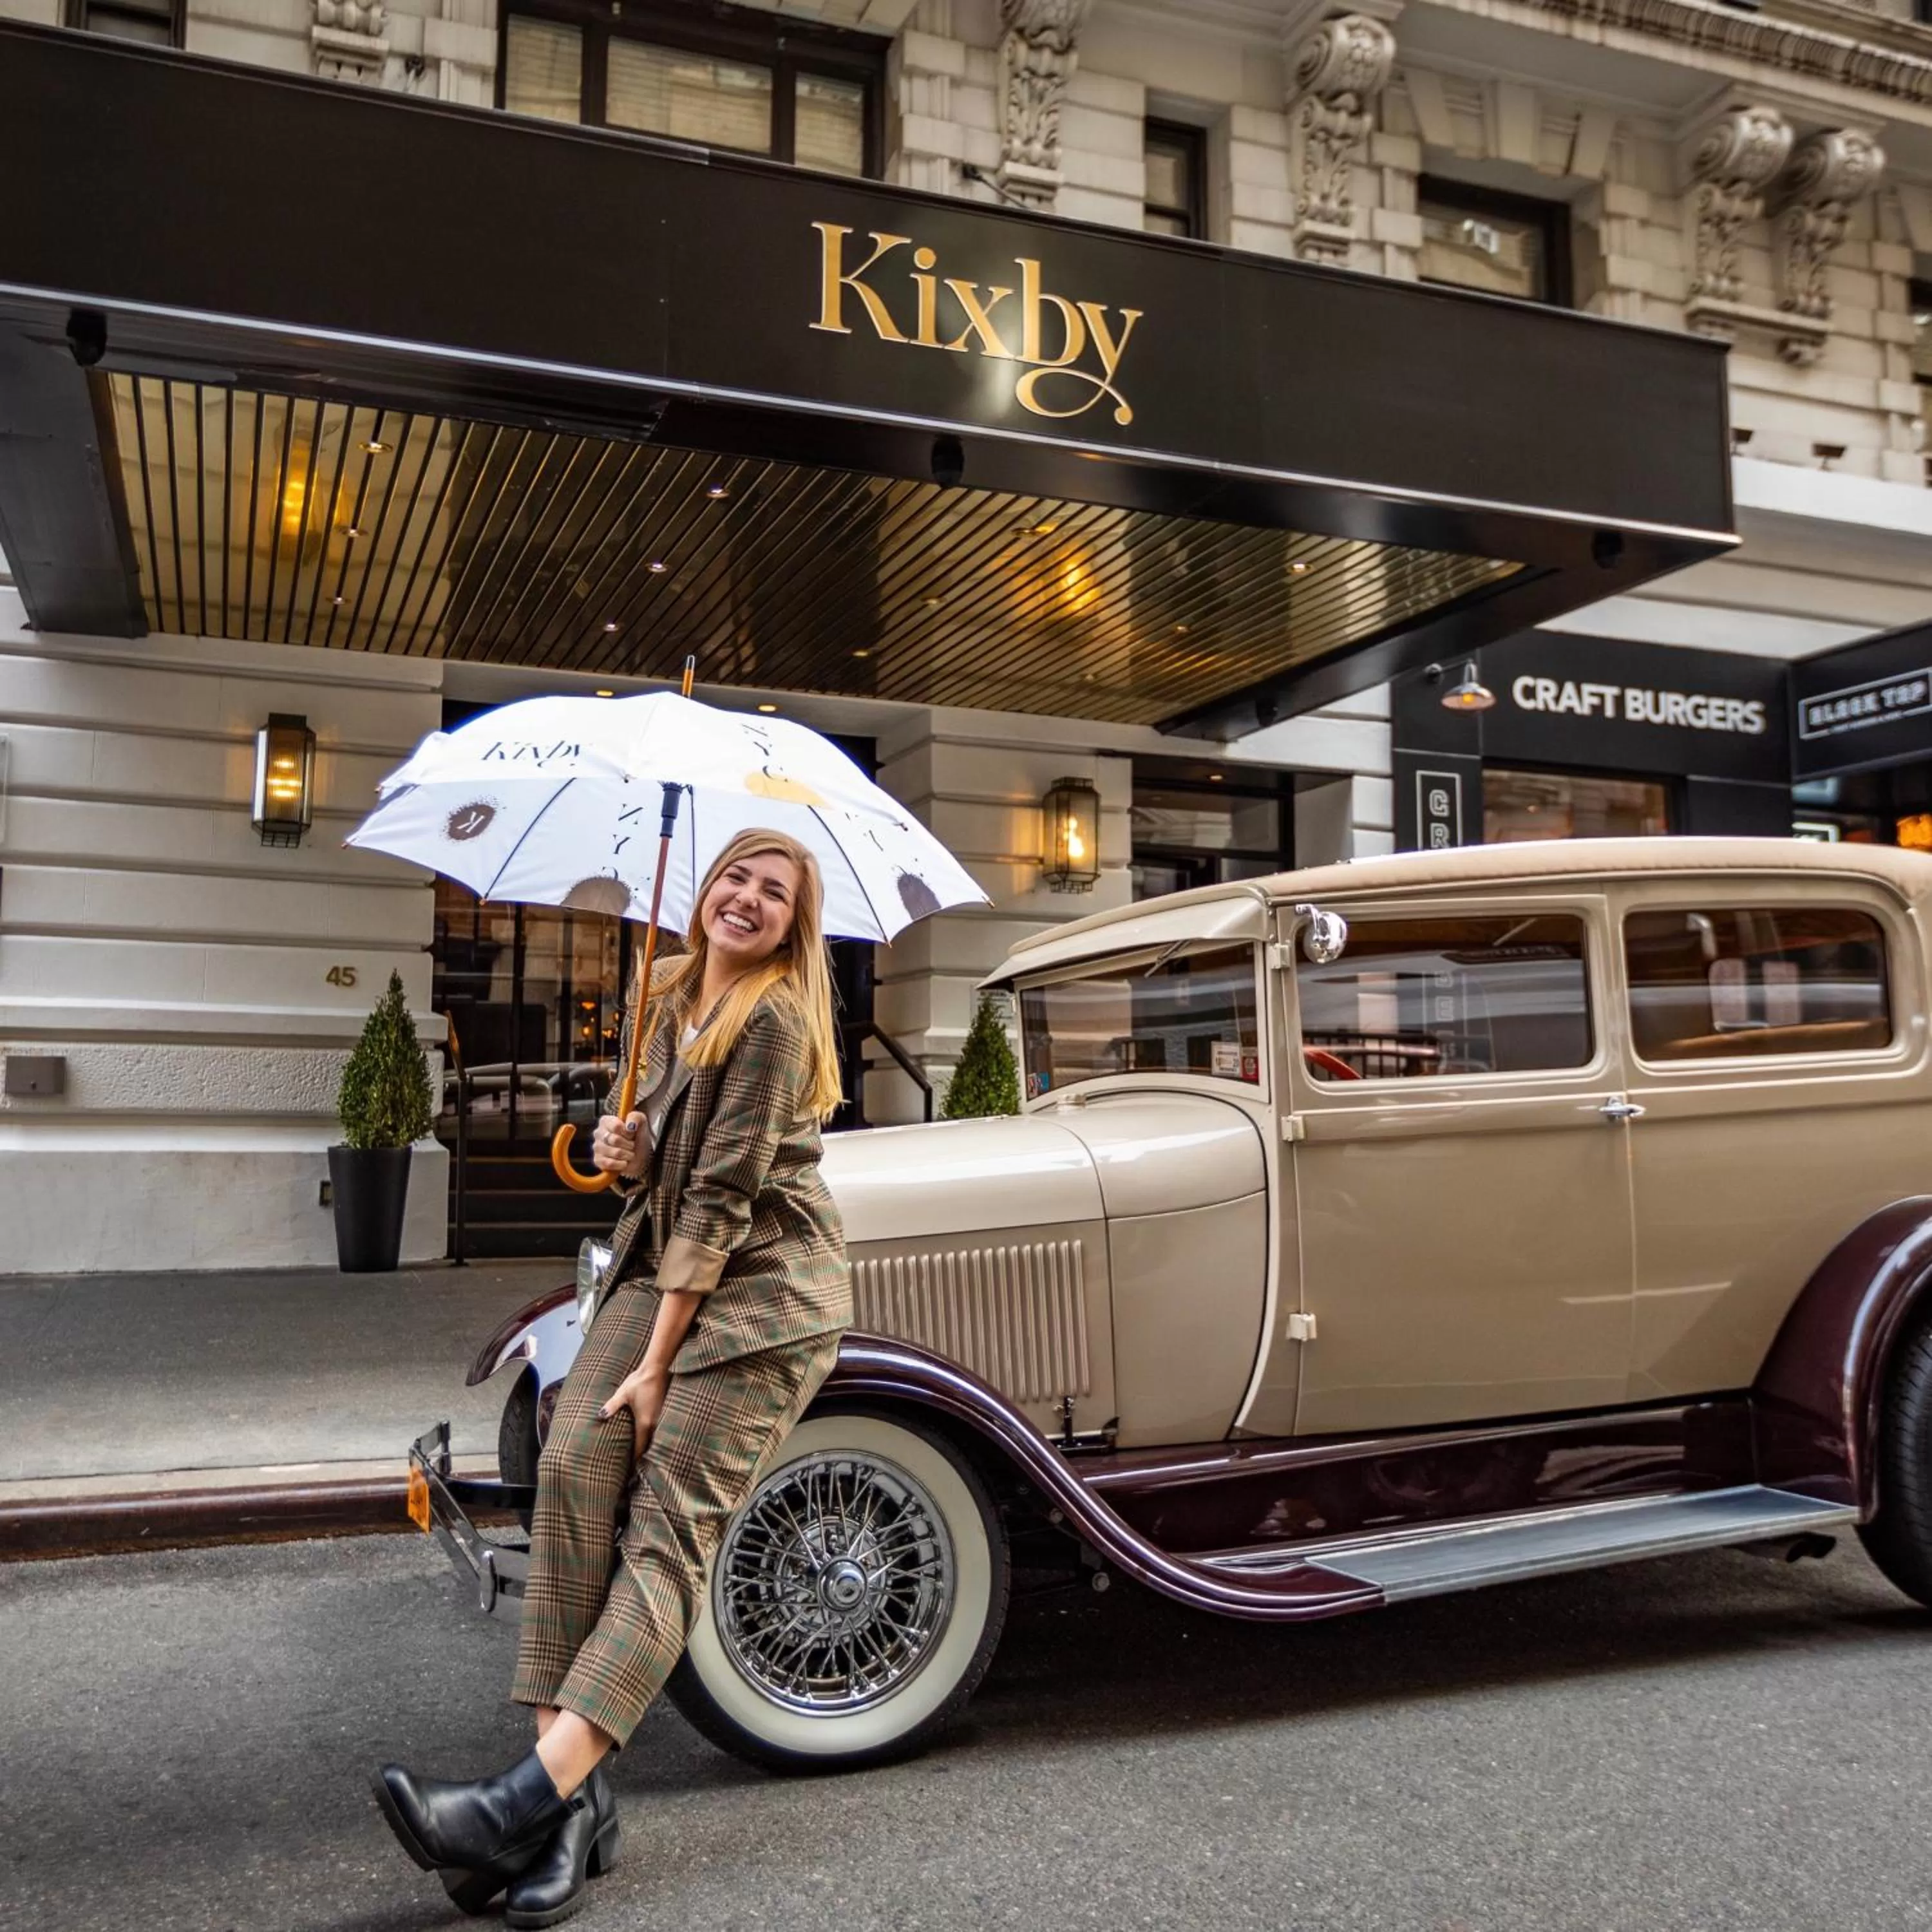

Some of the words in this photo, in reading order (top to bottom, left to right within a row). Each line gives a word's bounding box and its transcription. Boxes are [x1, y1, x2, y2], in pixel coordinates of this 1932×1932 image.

[809, 222, 1144, 426] Kixby
[1512, 675, 1621, 719] CRAFT
[1624, 687, 1766, 735] BURGERS
[325, 965, 356, 988] 45
